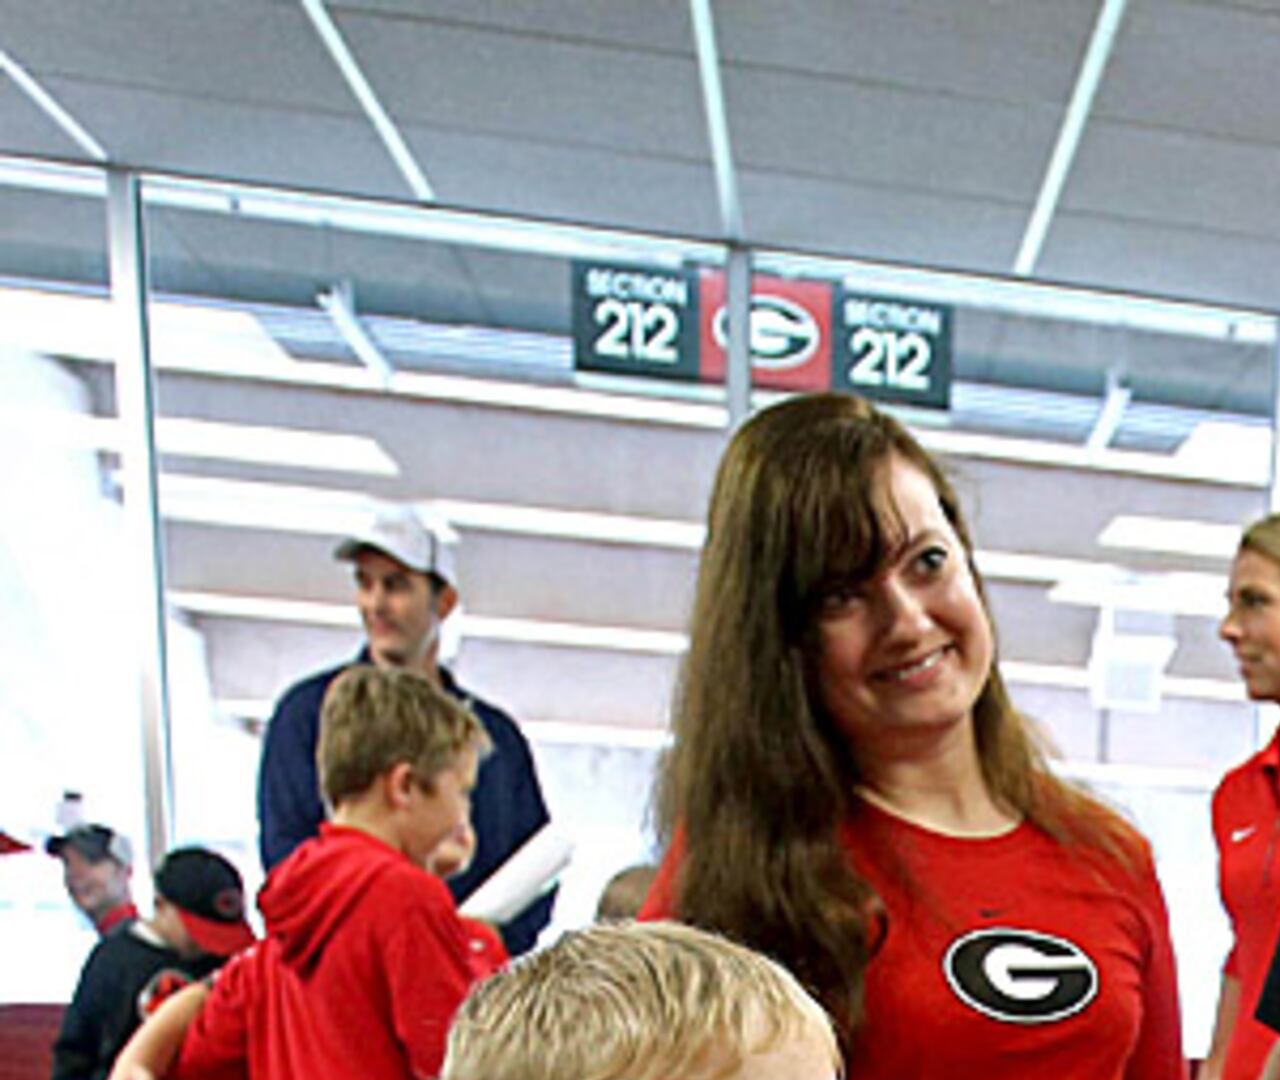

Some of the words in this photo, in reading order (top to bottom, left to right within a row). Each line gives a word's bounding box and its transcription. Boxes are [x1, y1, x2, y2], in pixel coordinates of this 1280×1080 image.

[586, 269, 687, 304] SECTION
[845, 300, 941, 335] SECTION
[594, 300, 680, 363] 212
[850, 328, 932, 391] 212
[954, 935, 1094, 1013] G
